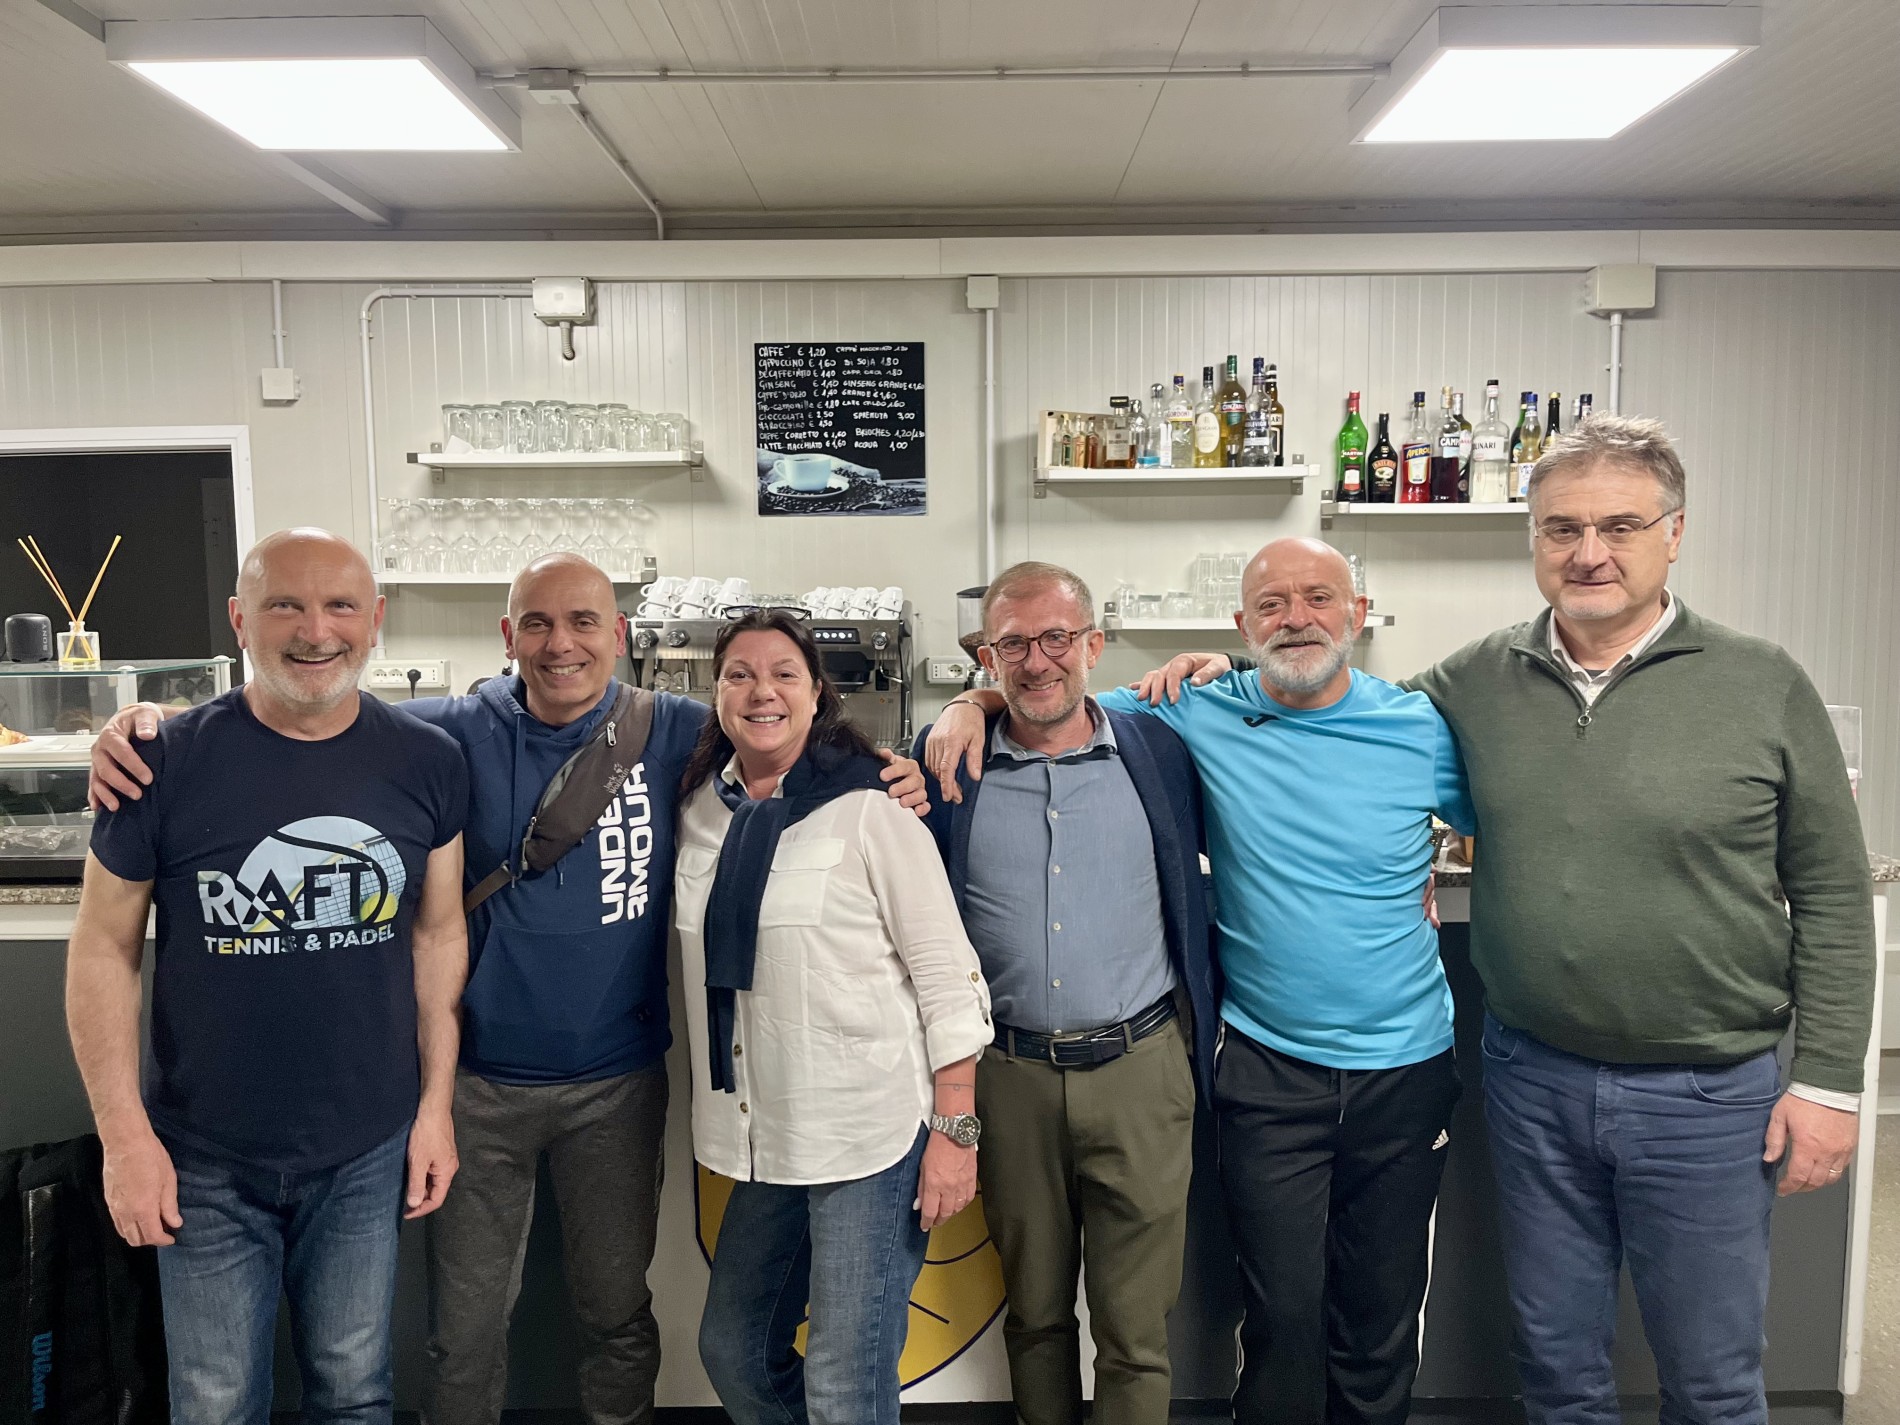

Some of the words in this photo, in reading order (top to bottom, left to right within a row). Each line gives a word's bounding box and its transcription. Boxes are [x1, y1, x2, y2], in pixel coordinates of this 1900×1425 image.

[808, 346, 826, 357] 1,20
[759, 380, 796, 390] GINSENG
[843, 380, 876, 388] GINSENG
[878, 381, 907, 390] GRANDE
[842, 389, 871, 398] GRANDE
[855, 427, 891, 437] BRIOCHES
[1440, 437, 1460, 446] CAMP
[1407, 446, 1431, 459] APEROL
[597, 797, 627, 925] UNDE
[204, 935, 297, 955] TENNIS
[304, 933, 322, 951] &
[329, 923, 395, 949] PADEL
